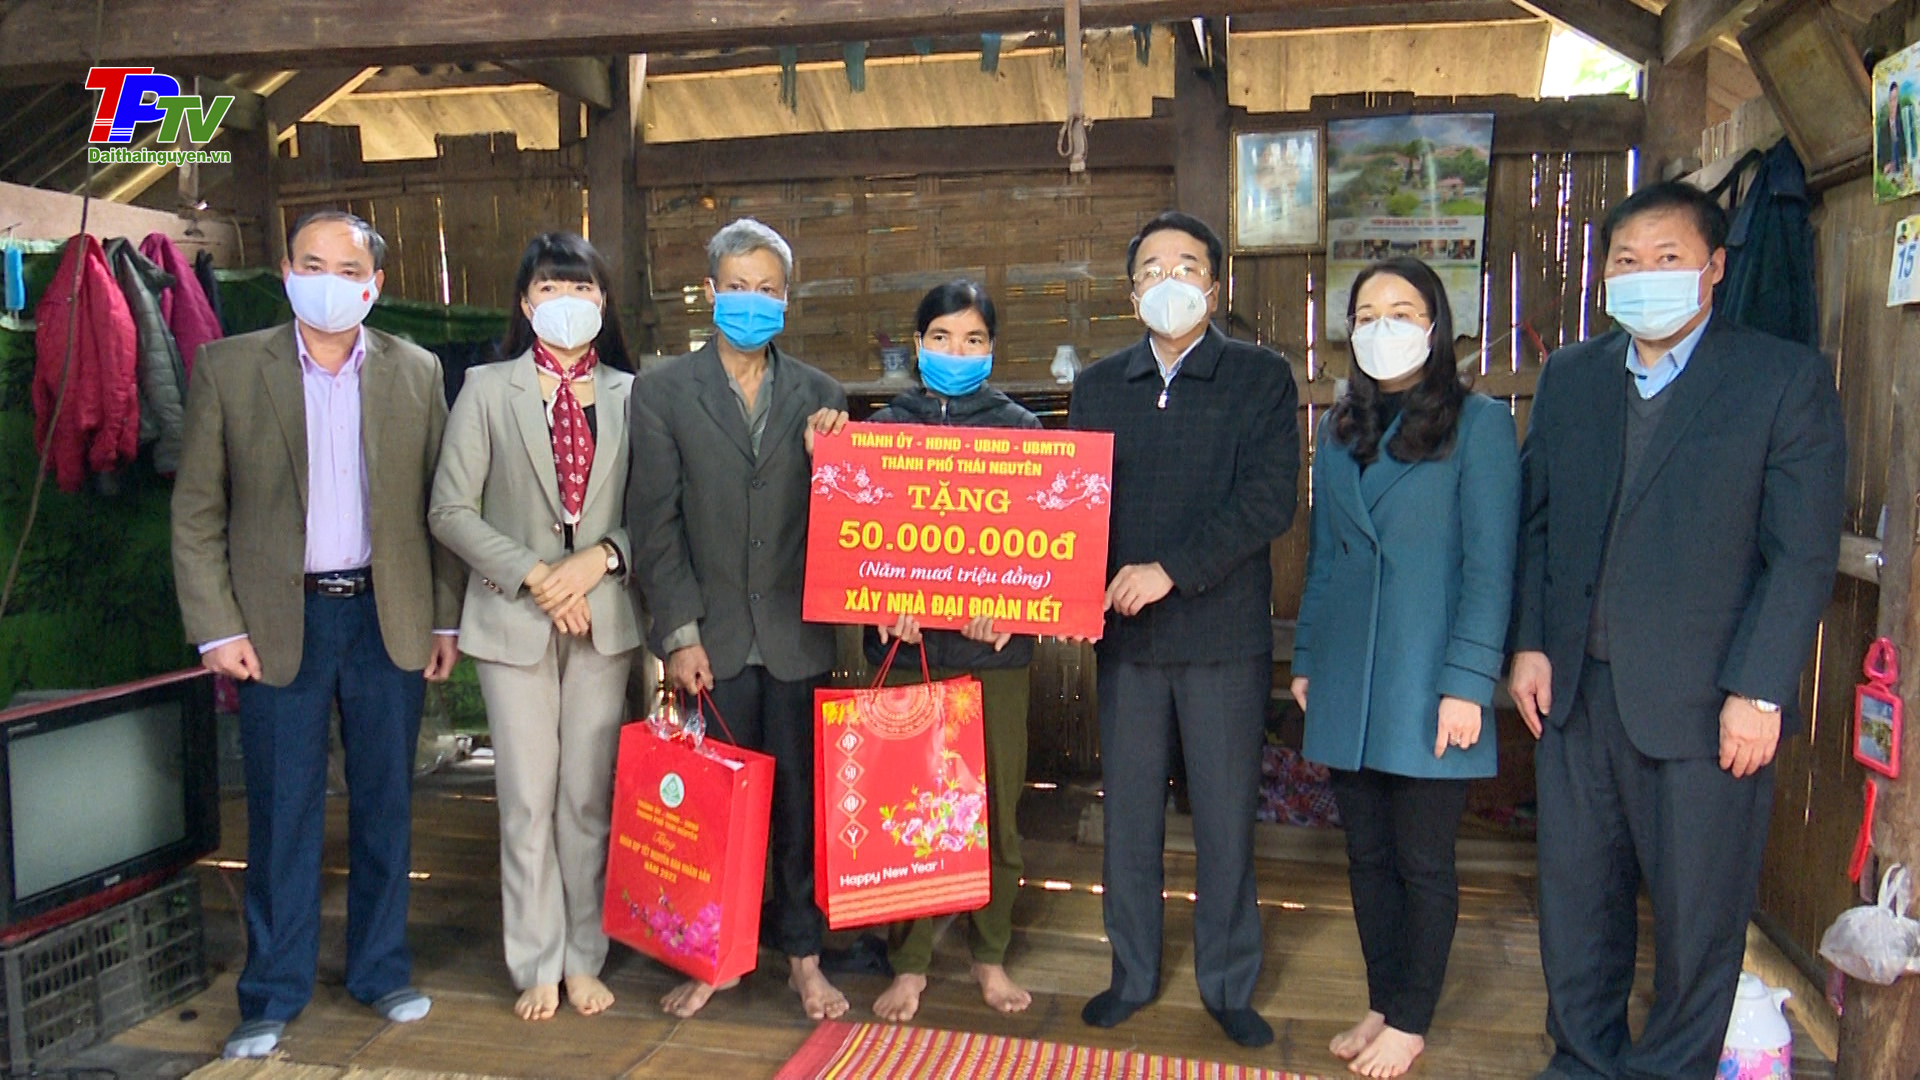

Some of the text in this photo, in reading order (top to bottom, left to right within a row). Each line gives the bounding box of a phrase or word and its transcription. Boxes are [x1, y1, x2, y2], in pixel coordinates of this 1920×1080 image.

[851, 433, 893, 448] THÀNH
[974, 440, 1010, 453] UBND
[1023, 441, 1076, 457] UBMTTQ
[881, 455, 1042, 476] THÀNH PHỐ THÁI NGUYÊN
[908, 480, 1011, 517] TẶNG
[838, 519, 1077, 560] 50.000.000đ
[859, 561, 905, 578] (Năm
[957, 566, 997, 586] triệu
[1001, 565, 1051, 590] đồng)
[845, 585, 1063, 623] XÂY NHÀ ĐẠI ĐOÀN KẾT
[840, 871, 881, 888] Happy
[882, 866, 909, 880] New
[911, 861, 938, 874] Year
